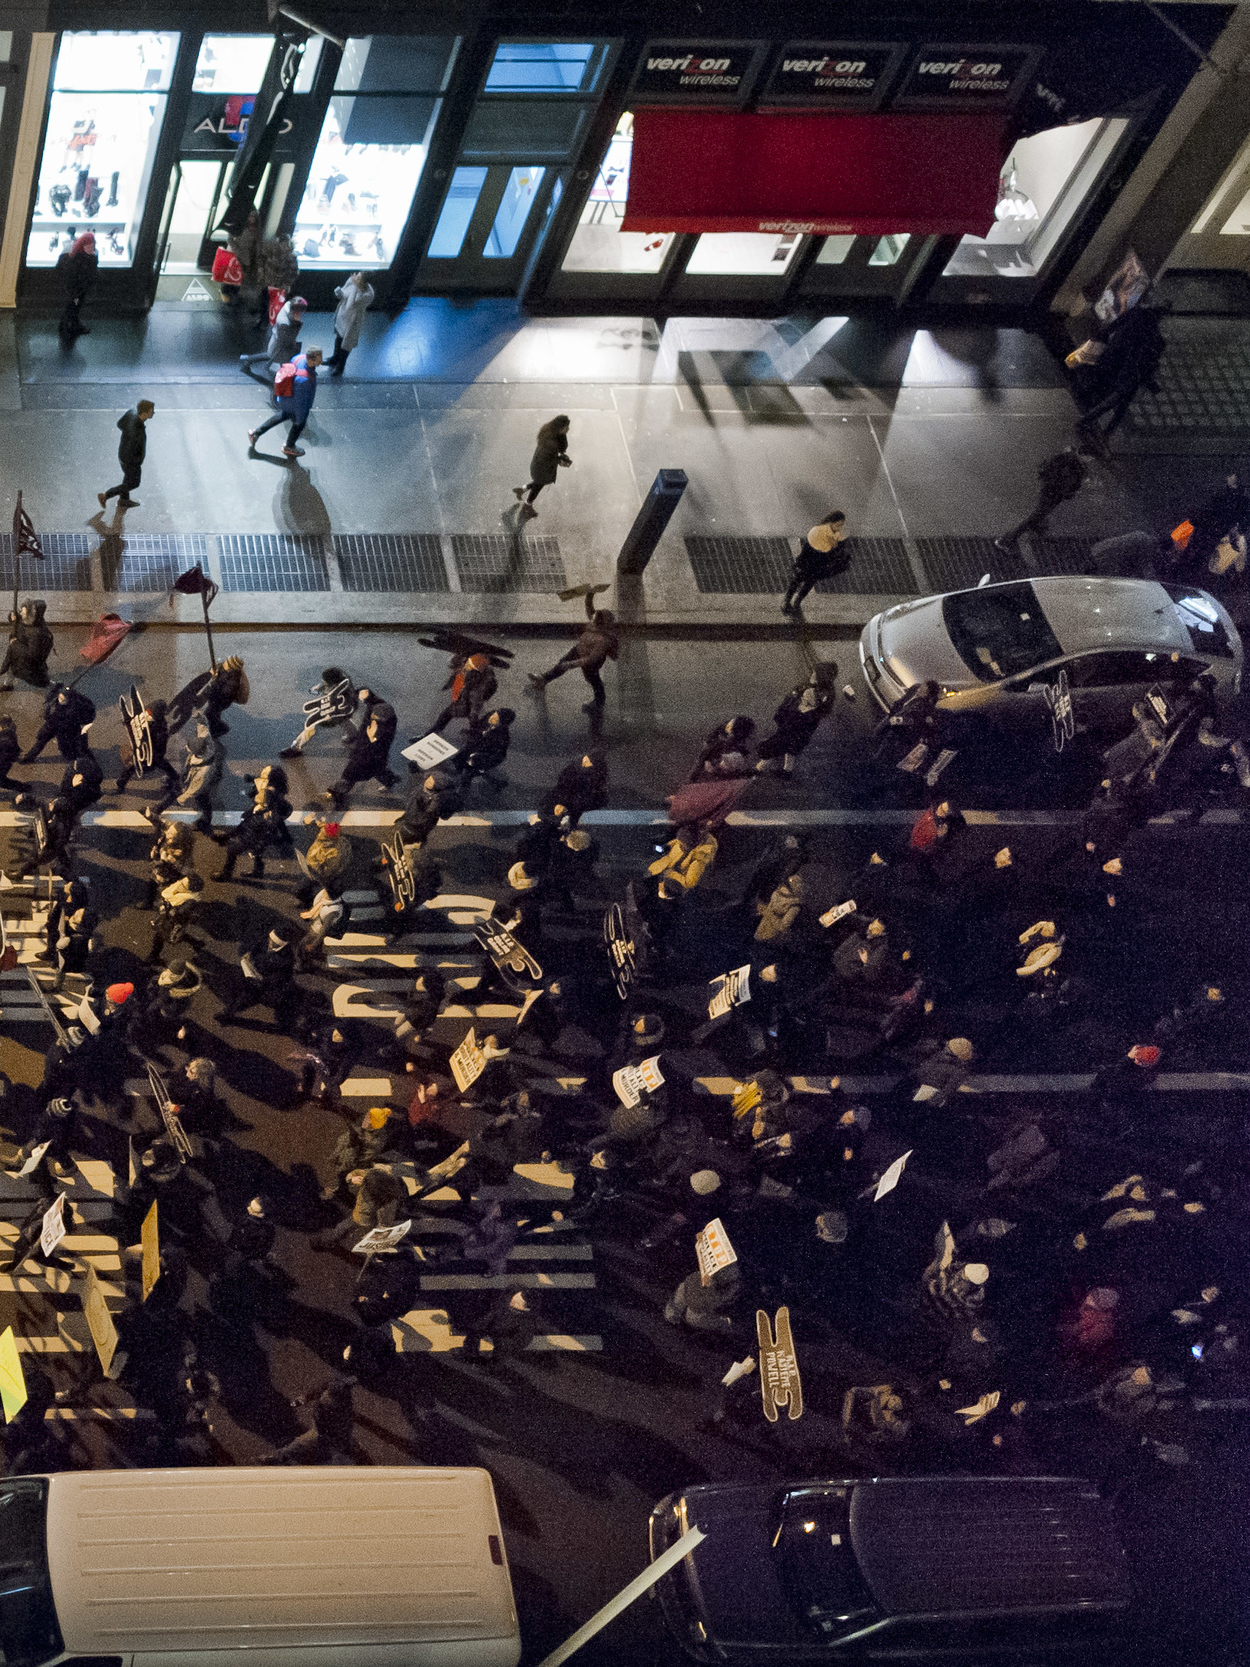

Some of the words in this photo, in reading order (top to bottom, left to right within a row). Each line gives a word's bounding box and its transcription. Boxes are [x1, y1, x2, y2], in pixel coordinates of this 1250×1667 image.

[647, 55, 731, 74] verizon
[782, 56, 867, 76] verizon
[918, 59, 1003, 77] verizon
[679, 74, 741, 86] wireless
[814, 77, 875, 88] wireless
[949, 78, 1010, 90] wireless
[758, 220, 815, 233] verizon
